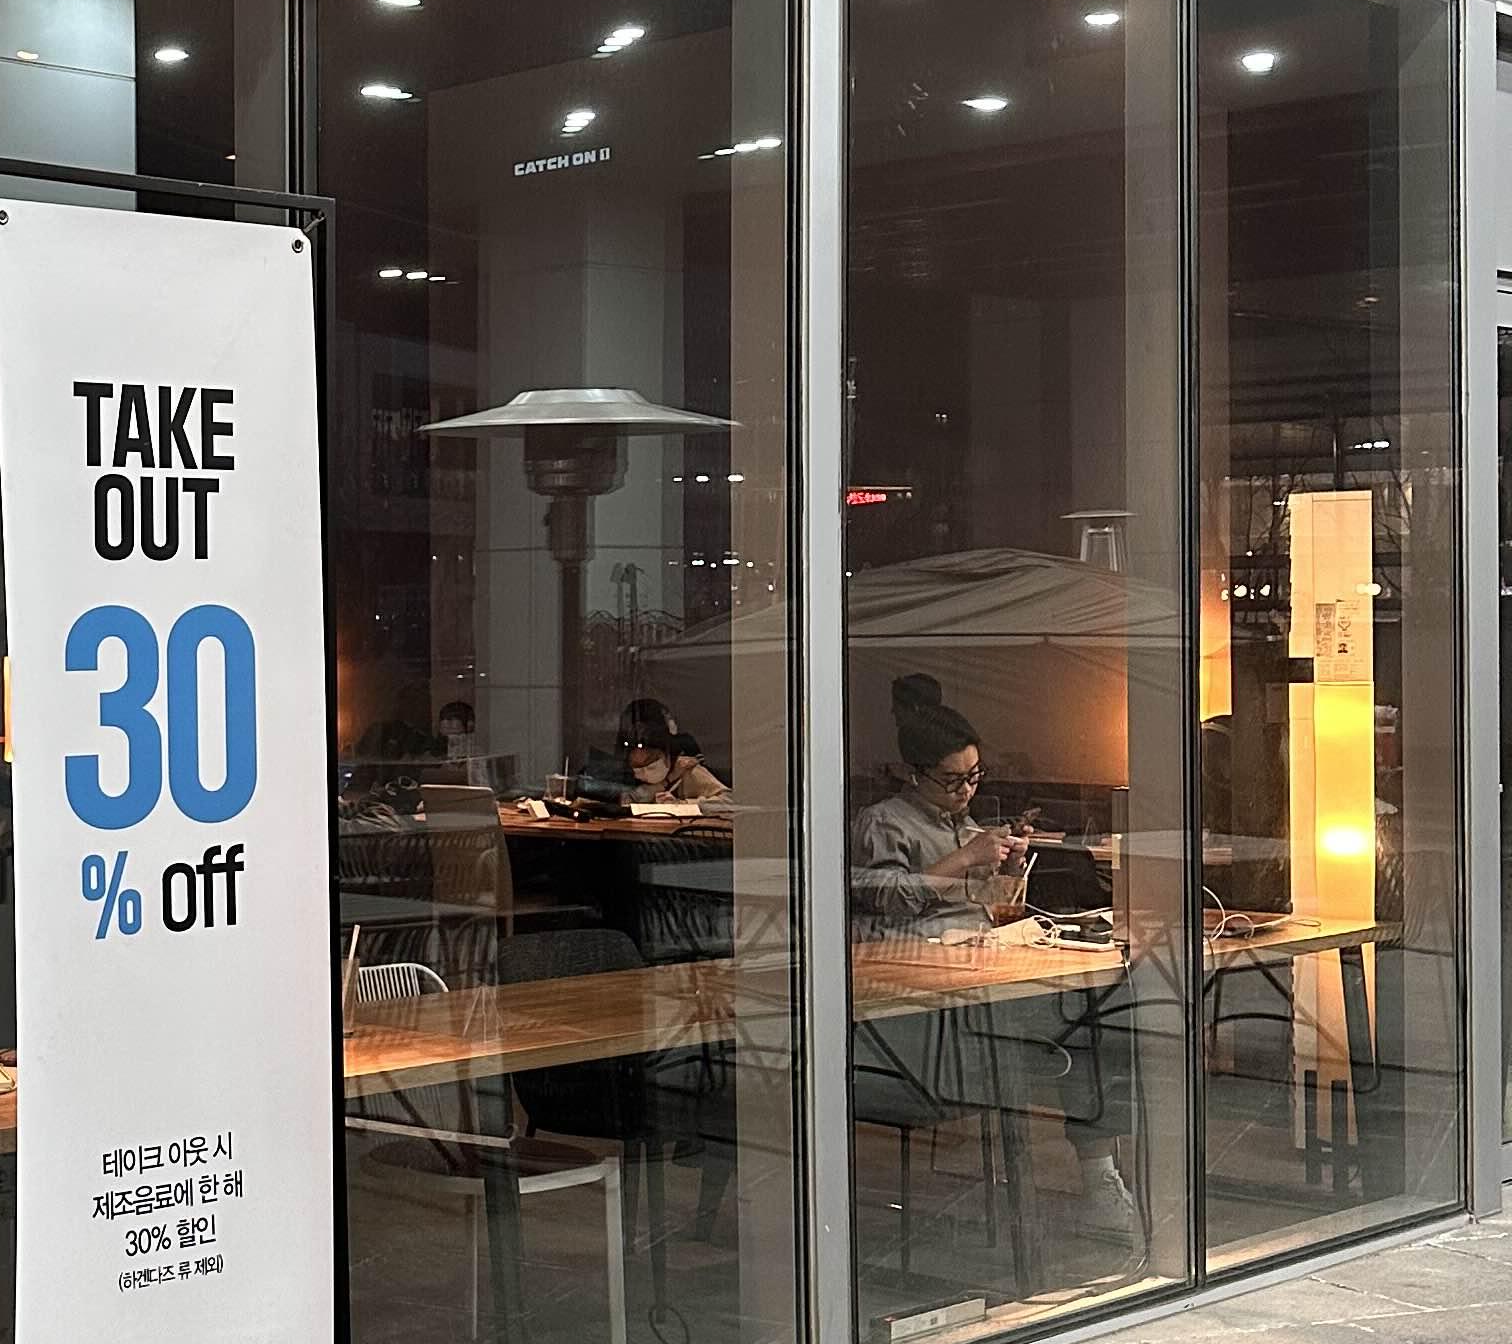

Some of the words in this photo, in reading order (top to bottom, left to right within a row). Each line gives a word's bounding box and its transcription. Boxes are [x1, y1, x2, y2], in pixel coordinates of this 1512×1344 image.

[514, 155, 569, 175] CATCH
[572, 150, 596, 166] ON
[73, 381, 235, 471] TAKE
[94, 474, 220, 561] OUT
[64, 603, 257, 830] 30
[81, 850, 142, 939] %
[162, 843, 245, 933] off
[102, 1145, 164, 1177] 테이크
[168, 1136, 208, 1167] 아웃
[213, 1131, 232, 1160] 시
[92, 1177, 193, 1220] 제조음료에
[198, 1173, 220, 1204] 한
[223, 1169, 243, 1198] 해
[125, 1223, 171, 1257] 30%
[176, 1213, 216, 1248] 할인
[119, 1265, 176, 1292] (하겐다즈
[178, 1261, 192, 1280] 류
[194, 1254, 224, 1275] 제외)
